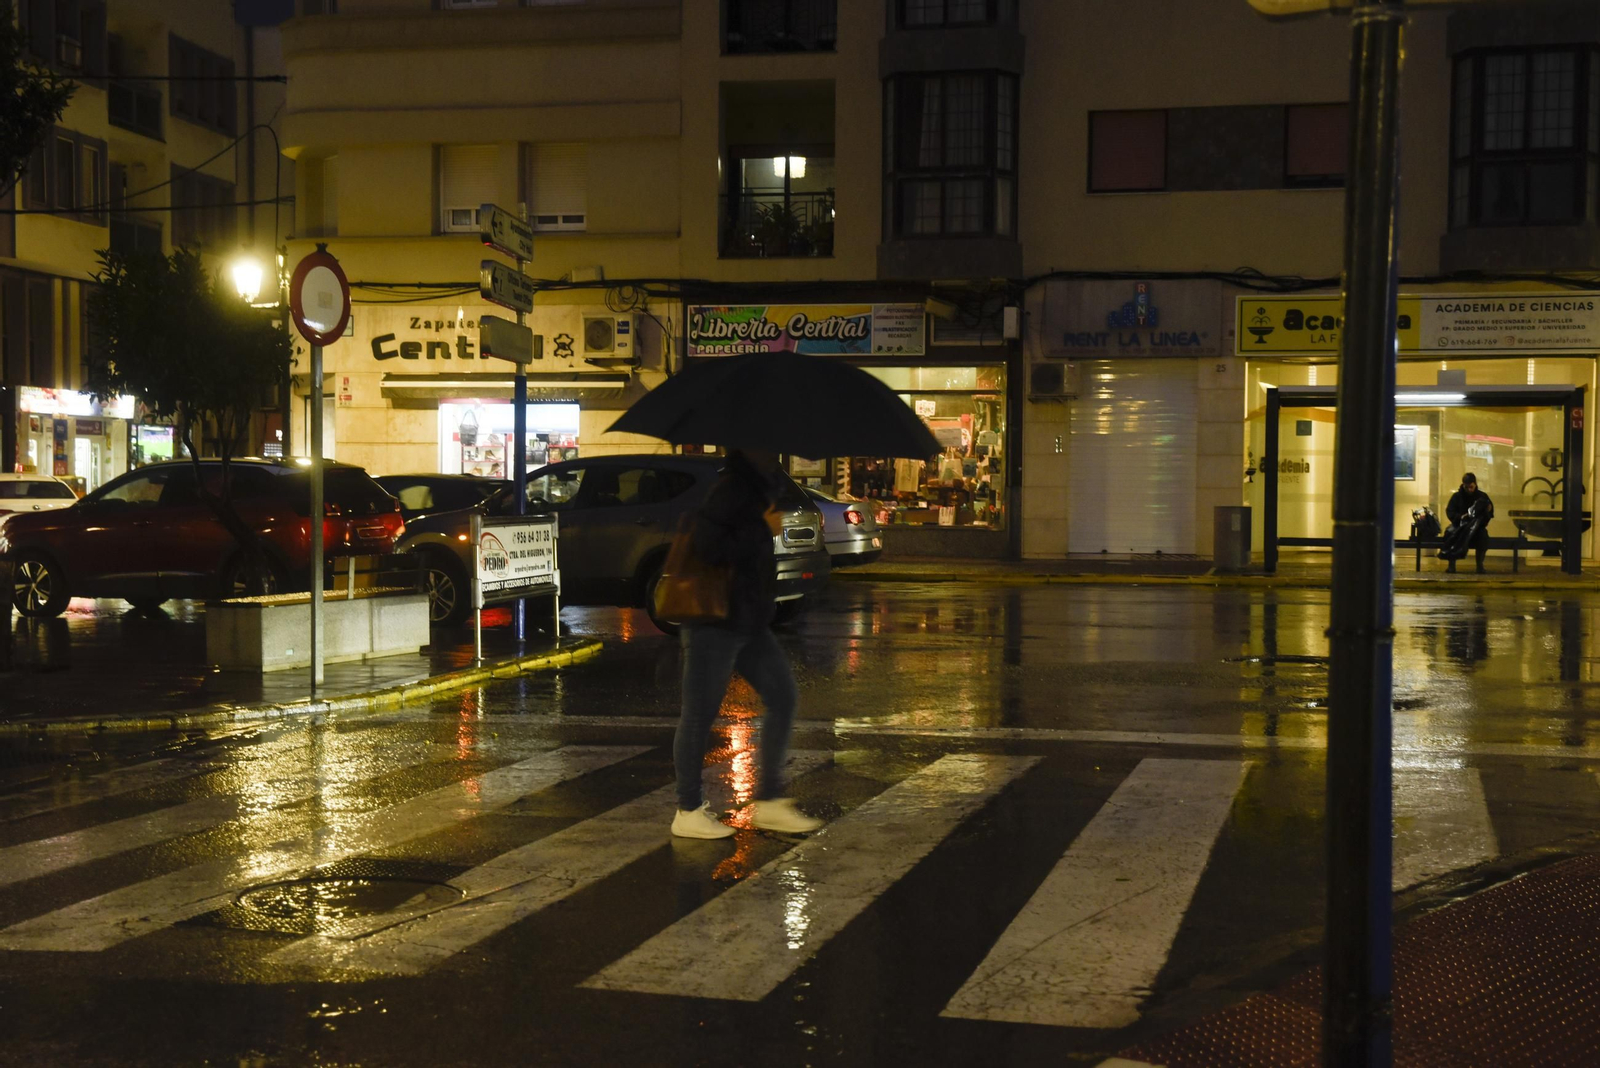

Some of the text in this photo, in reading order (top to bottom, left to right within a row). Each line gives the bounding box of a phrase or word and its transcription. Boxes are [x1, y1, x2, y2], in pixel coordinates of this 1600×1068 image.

[1137, 283, 1147, 325] RENT
[1435, 301, 1594, 313] ACADEMIA DE CIENCIAS
[410, 317, 482, 333] Zapate
[788, 312, 866, 339] Central
[1283, 309, 1411, 331] acaa
[371, 332, 543, 361] Centl
[1063, 331, 1201, 347] RENT LA LINEA
[1310, 334, 1326, 344] LA
[1450, 338, 1498, 346] 619-664-769
[1216, 364, 1227, 372] 25
[1259, 456, 1310, 473] ademia
[516, 529, 550, 544] 956 64 31 38
[509, 550, 519, 560] CTRA.
[519, 549, 527, 559] DEL
[484, 557, 506, 571] PEDRO
